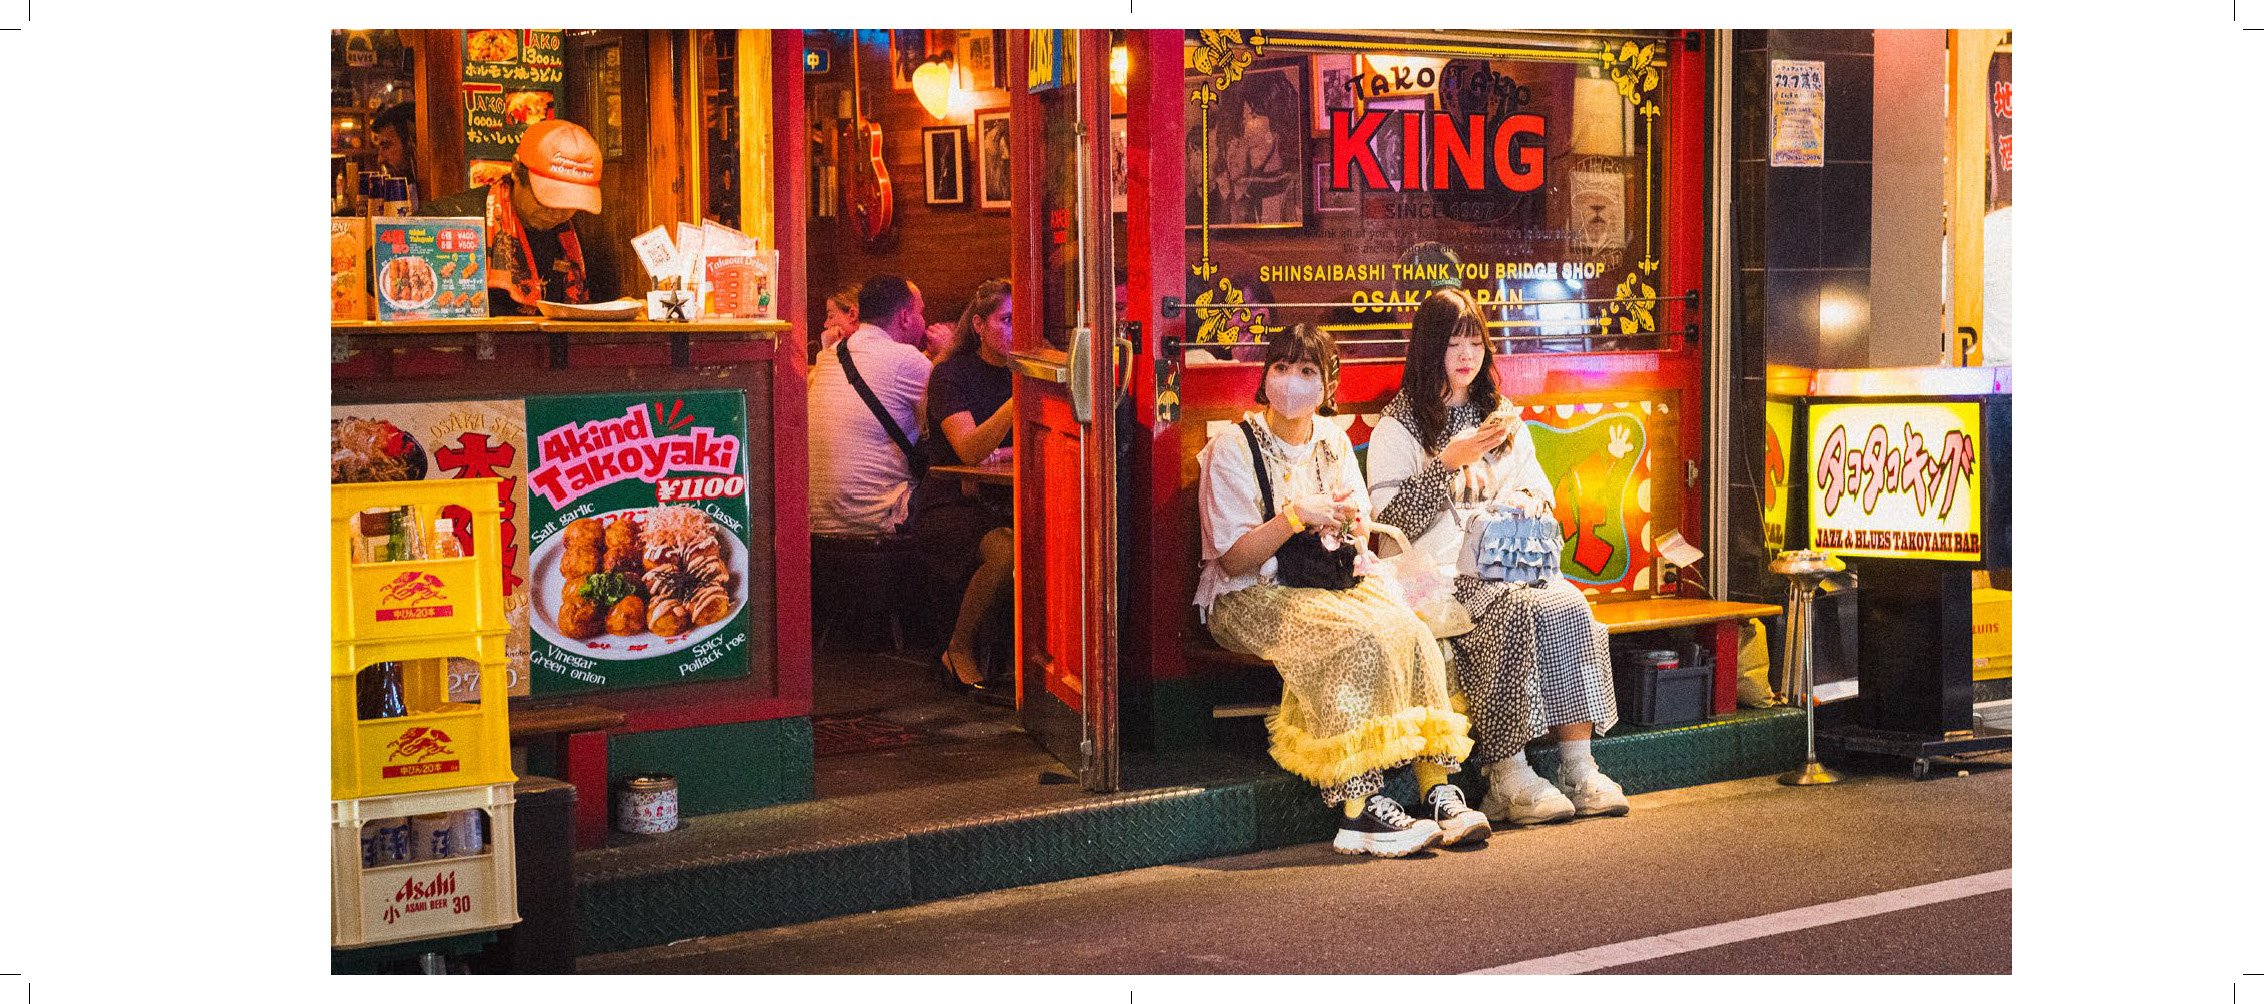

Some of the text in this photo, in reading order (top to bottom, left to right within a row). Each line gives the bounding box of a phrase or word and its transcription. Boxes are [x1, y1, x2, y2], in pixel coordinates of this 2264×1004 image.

[522, 29, 562, 50] TAKO
[462, 82, 506, 114] TAKO
[1344, 66, 1435, 100] TAKO
[1329, 108, 1547, 192] KING
[1385, 203, 1440, 219] SINCE
[1260, 262, 1605, 282] SHINSAIBASHI THANK YOU BRIDGE SHOP
[430, 413, 485, 438] OSAKA
[543, 409, 648, 463] 4kind
[533, 432, 734, 503] Takoyaki
[1818, 421, 1976, 525] タコタコキング
[657, 475, 744, 501] ¥1100
[531, 519, 558, 543] Salt
[559, 502, 596, 526] garlic
[705, 503, 744, 533] Classic
[1815, 529, 1981, 553] JAZZ & BLUES TAKOYAKI BAR
[547, 645, 598, 670] Vinegar
[679, 632, 747, 676] Pollack roe
[692, 632, 725, 658] Spicy
[530, 650, 607, 685] Green onion
[395, 871, 455, 902] Asahi
[383, 895, 471, 924] 小 ASAHI BEER 30
